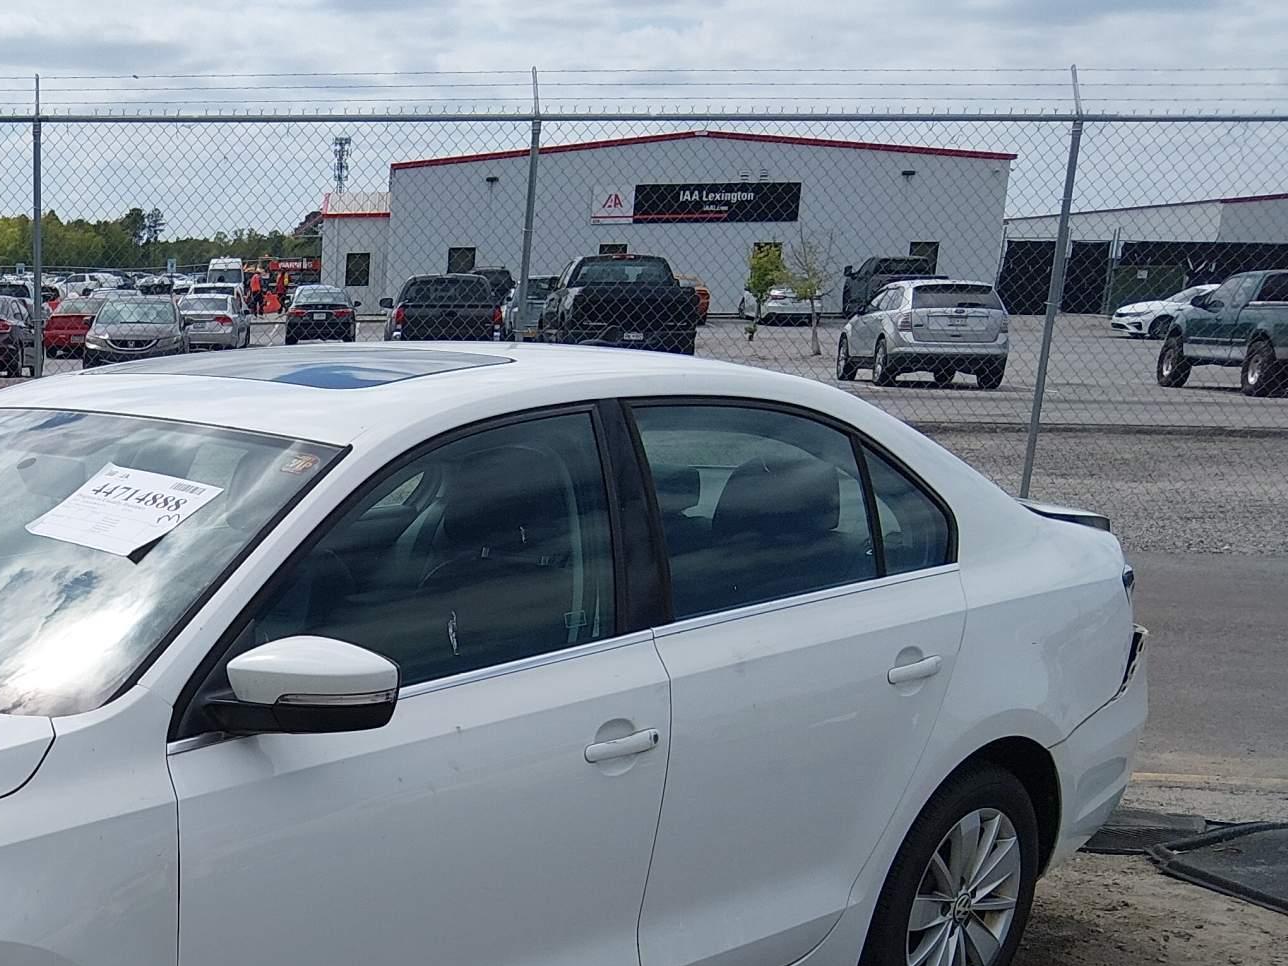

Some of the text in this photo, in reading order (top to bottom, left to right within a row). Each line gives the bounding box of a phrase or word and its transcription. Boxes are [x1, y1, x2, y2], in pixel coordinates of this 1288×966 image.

[679, 190, 754, 203] IAA Lexington
[91, 482, 188, 512] 44714888
